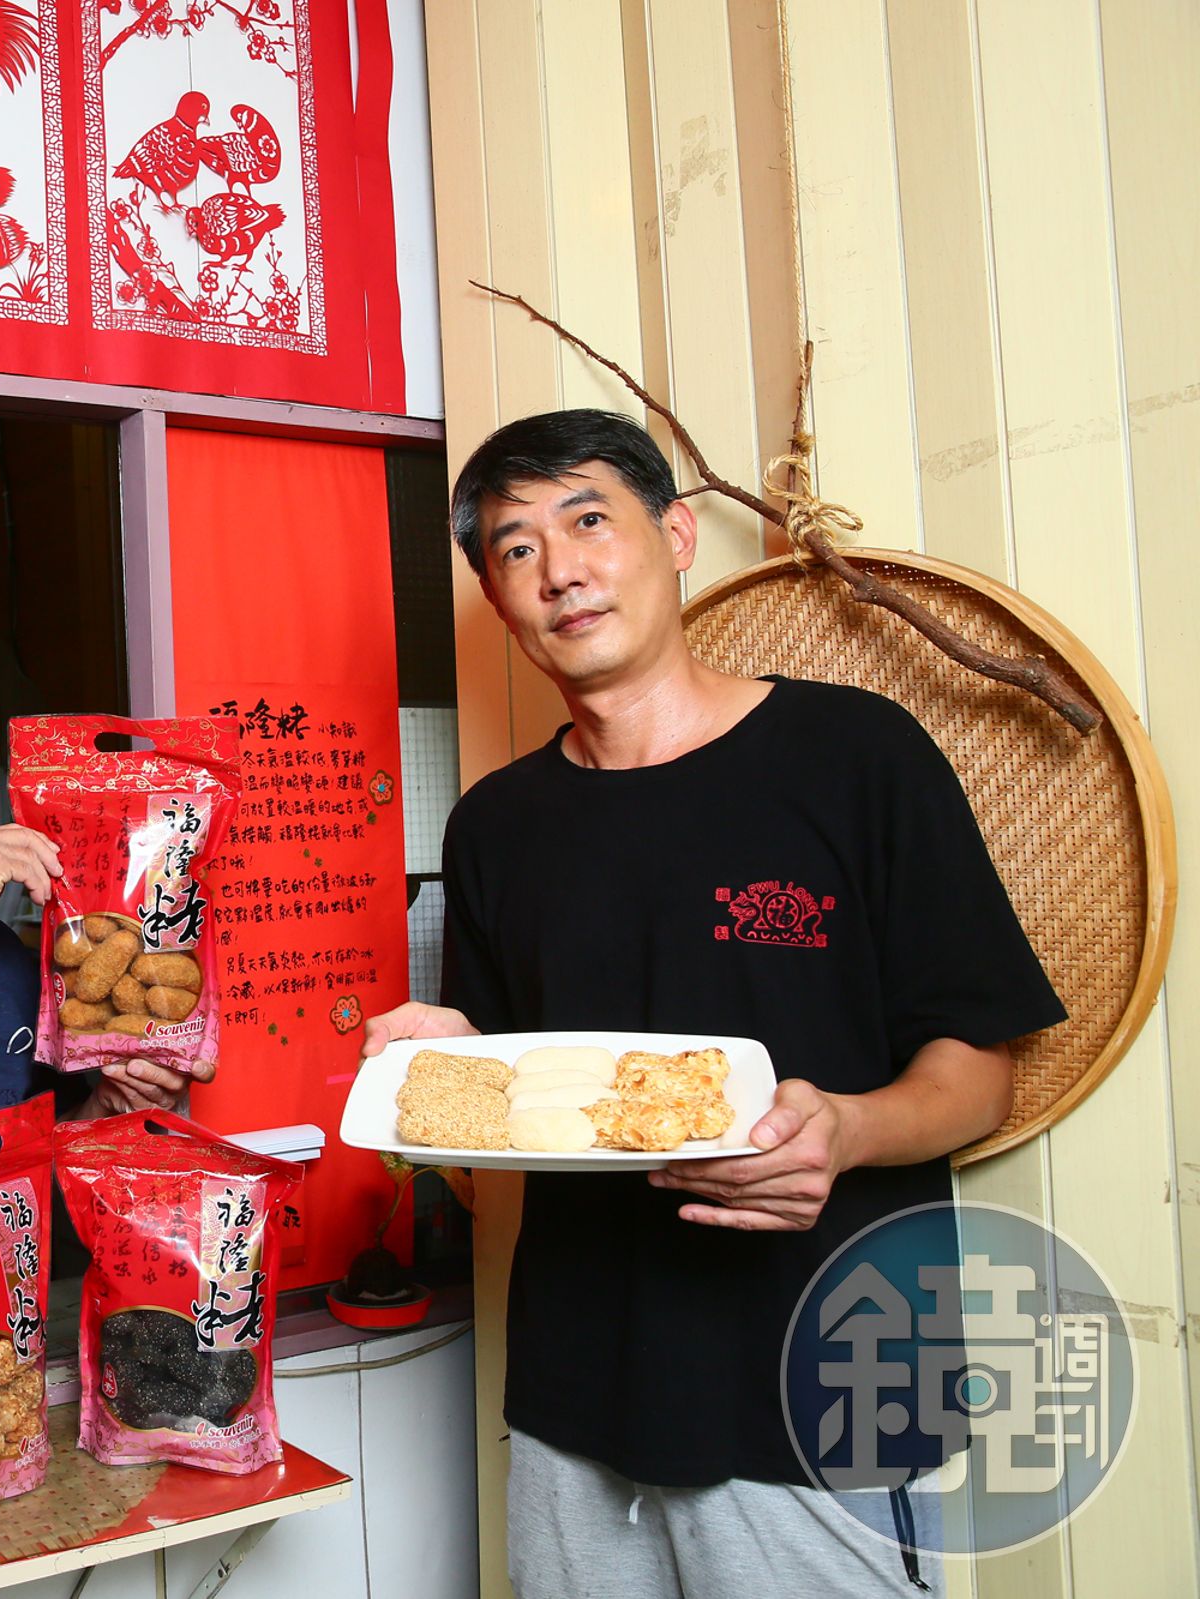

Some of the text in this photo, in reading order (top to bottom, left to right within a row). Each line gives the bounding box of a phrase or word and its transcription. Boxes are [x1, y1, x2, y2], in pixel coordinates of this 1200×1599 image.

[318, 721, 357, 739] 小知識
[786, 882, 819, 912] LONG
[216, 929, 238, 946] 感！
[157, 1017, 205, 1037] souvenir
[276, 1205, 300, 1229] 取
[208, 1414, 255, 1439] souvenir
